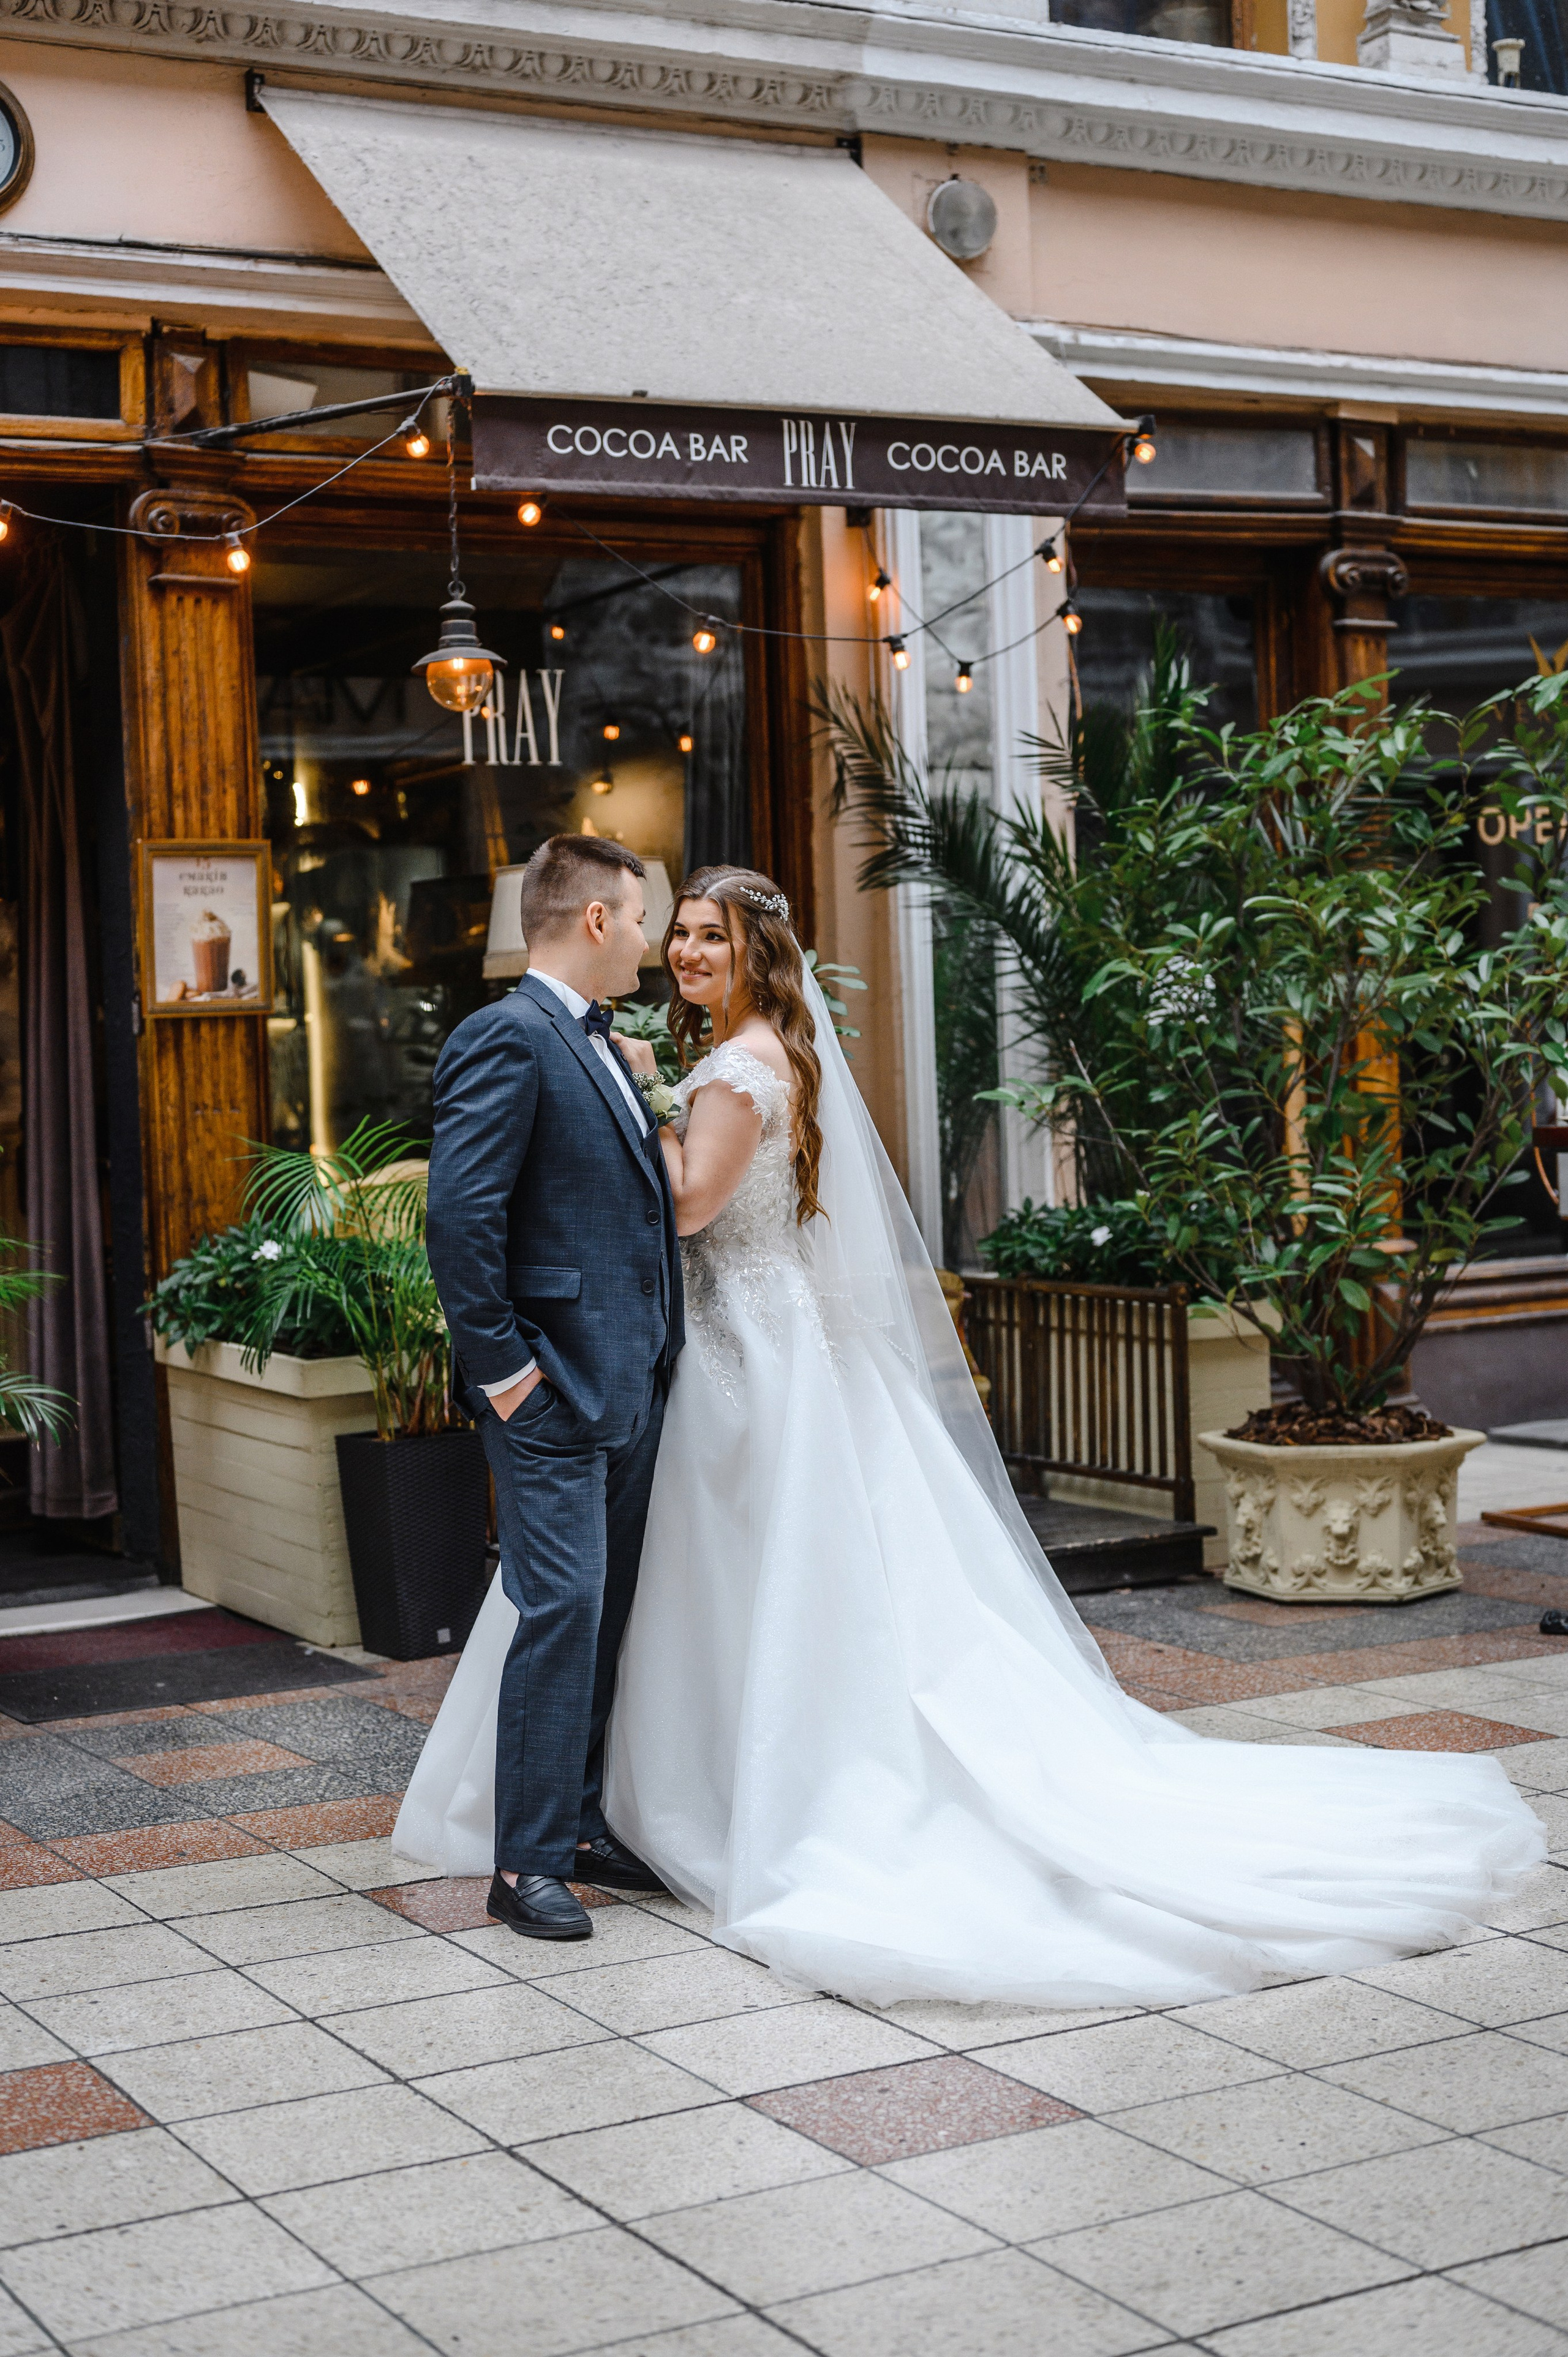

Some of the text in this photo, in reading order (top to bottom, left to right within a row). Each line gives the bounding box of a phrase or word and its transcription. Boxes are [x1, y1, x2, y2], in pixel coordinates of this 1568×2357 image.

[546, 418, 1068, 489] COCOA BAR PRAY COCOA BAR
[461, 668, 566, 766] PRAY
[1477, 805, 1568, 847] OPE
